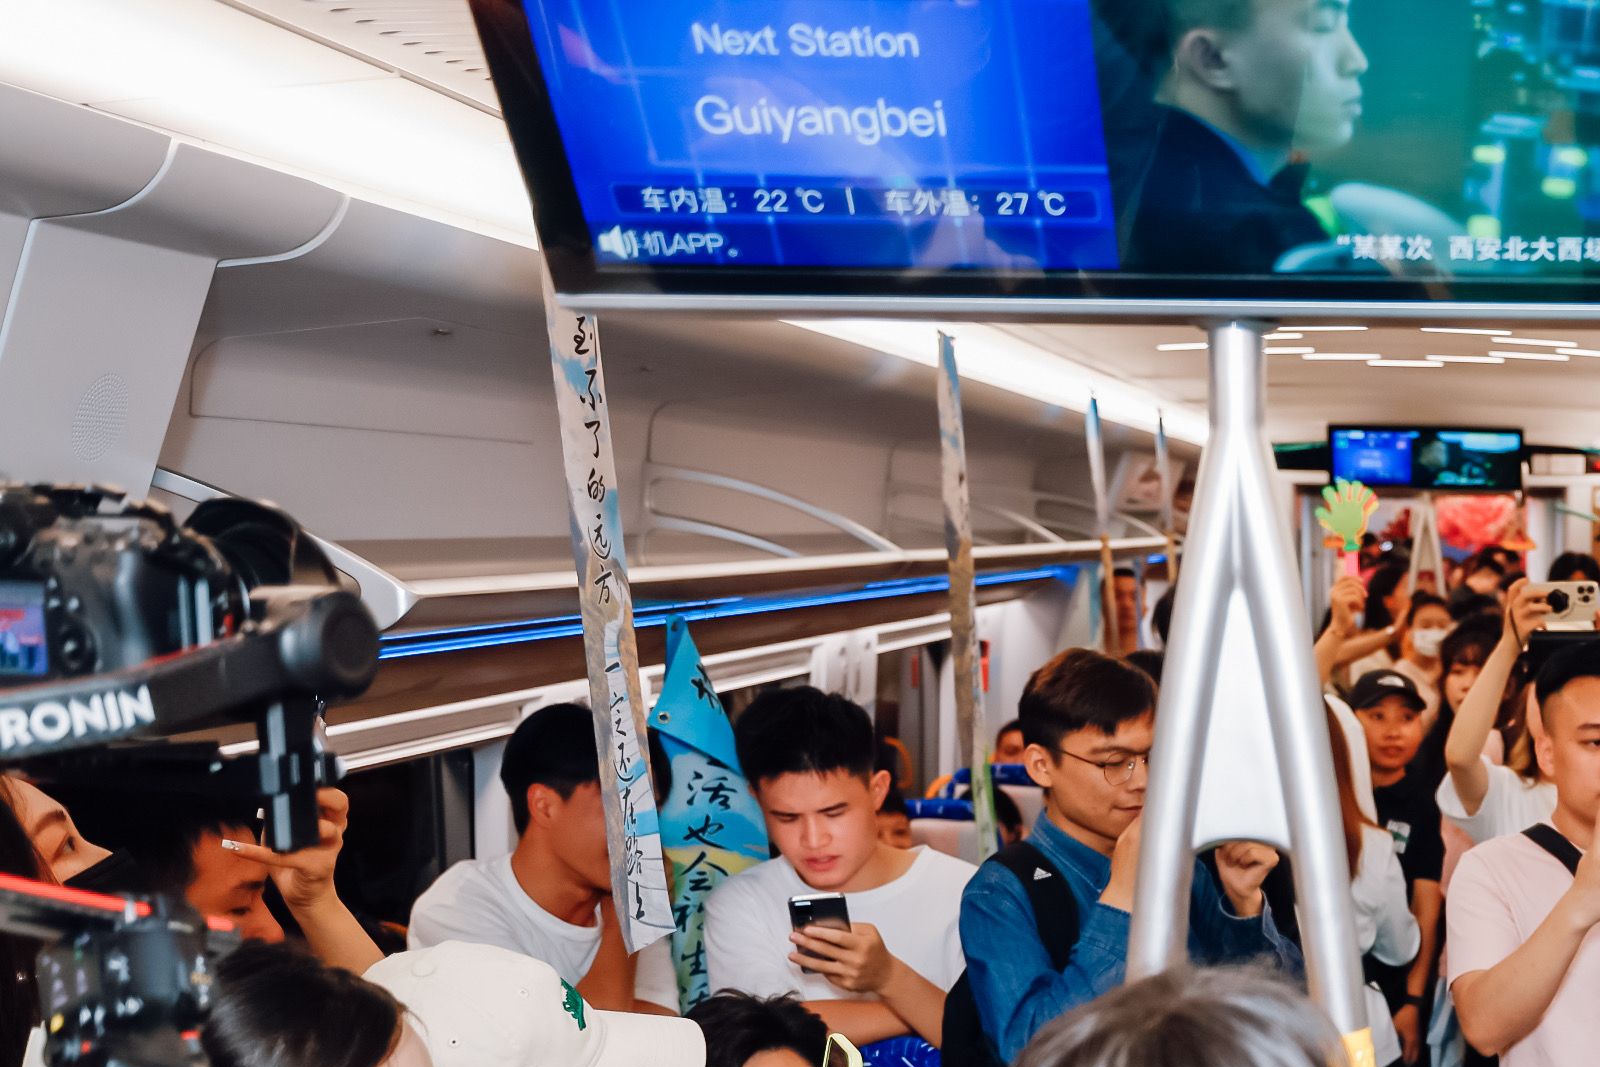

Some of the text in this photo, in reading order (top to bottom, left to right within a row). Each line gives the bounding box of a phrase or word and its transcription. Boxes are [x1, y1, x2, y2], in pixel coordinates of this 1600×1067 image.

[691, 22, 920, 58] Next Station
[694, 95, 947, 145] Guiyangbei
[0, 684, 156, 752] RONIN
